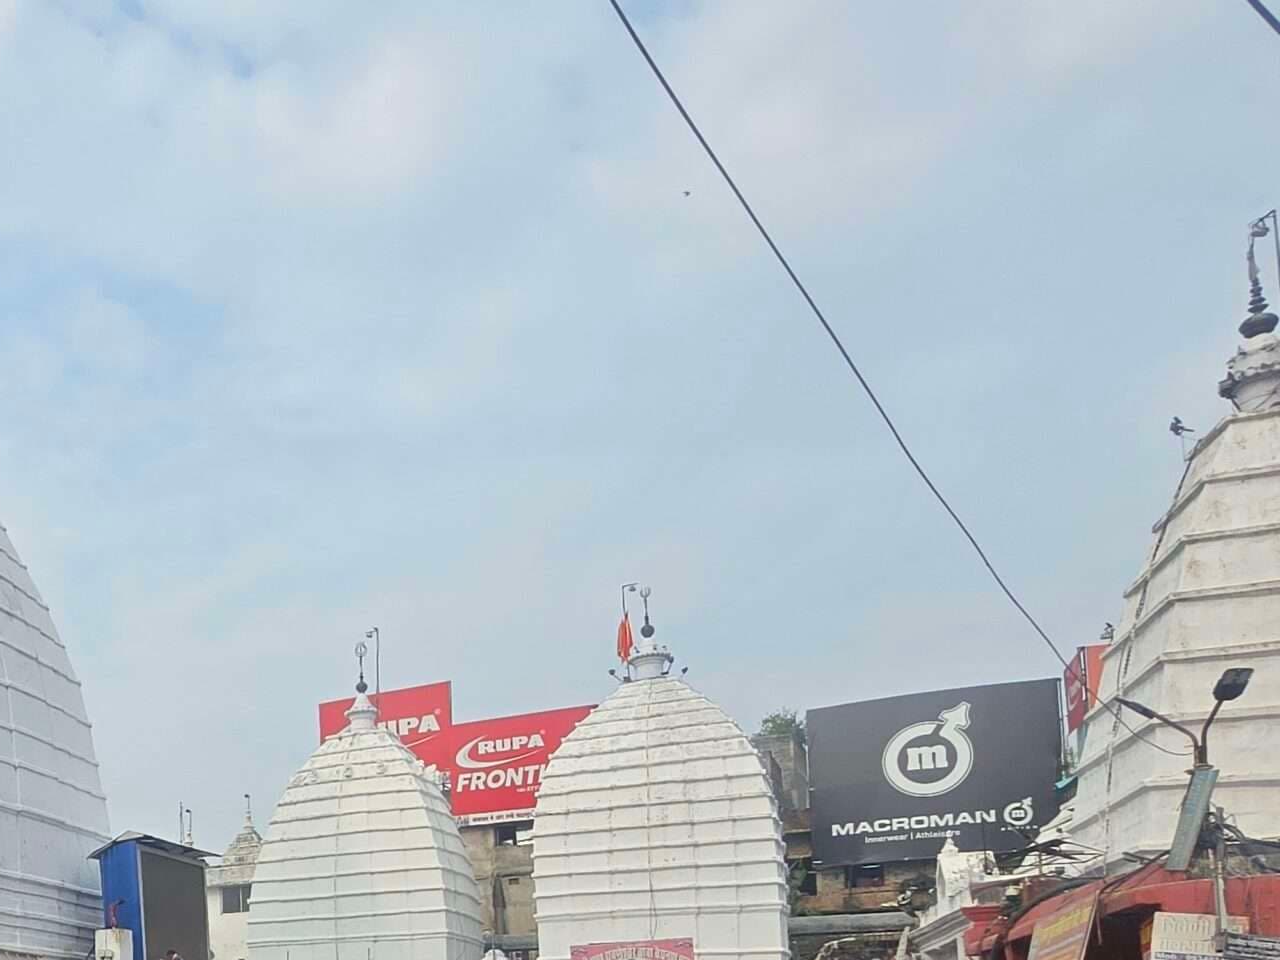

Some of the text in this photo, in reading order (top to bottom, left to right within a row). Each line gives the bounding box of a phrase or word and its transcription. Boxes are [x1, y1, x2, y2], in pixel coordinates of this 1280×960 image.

[376, 714, 441, 737] UPA
[478, 733, 545, 755] RUPA
[831, 808, 997, 837] MACROMAN
[864, 834, 910, 844] Innerwear
